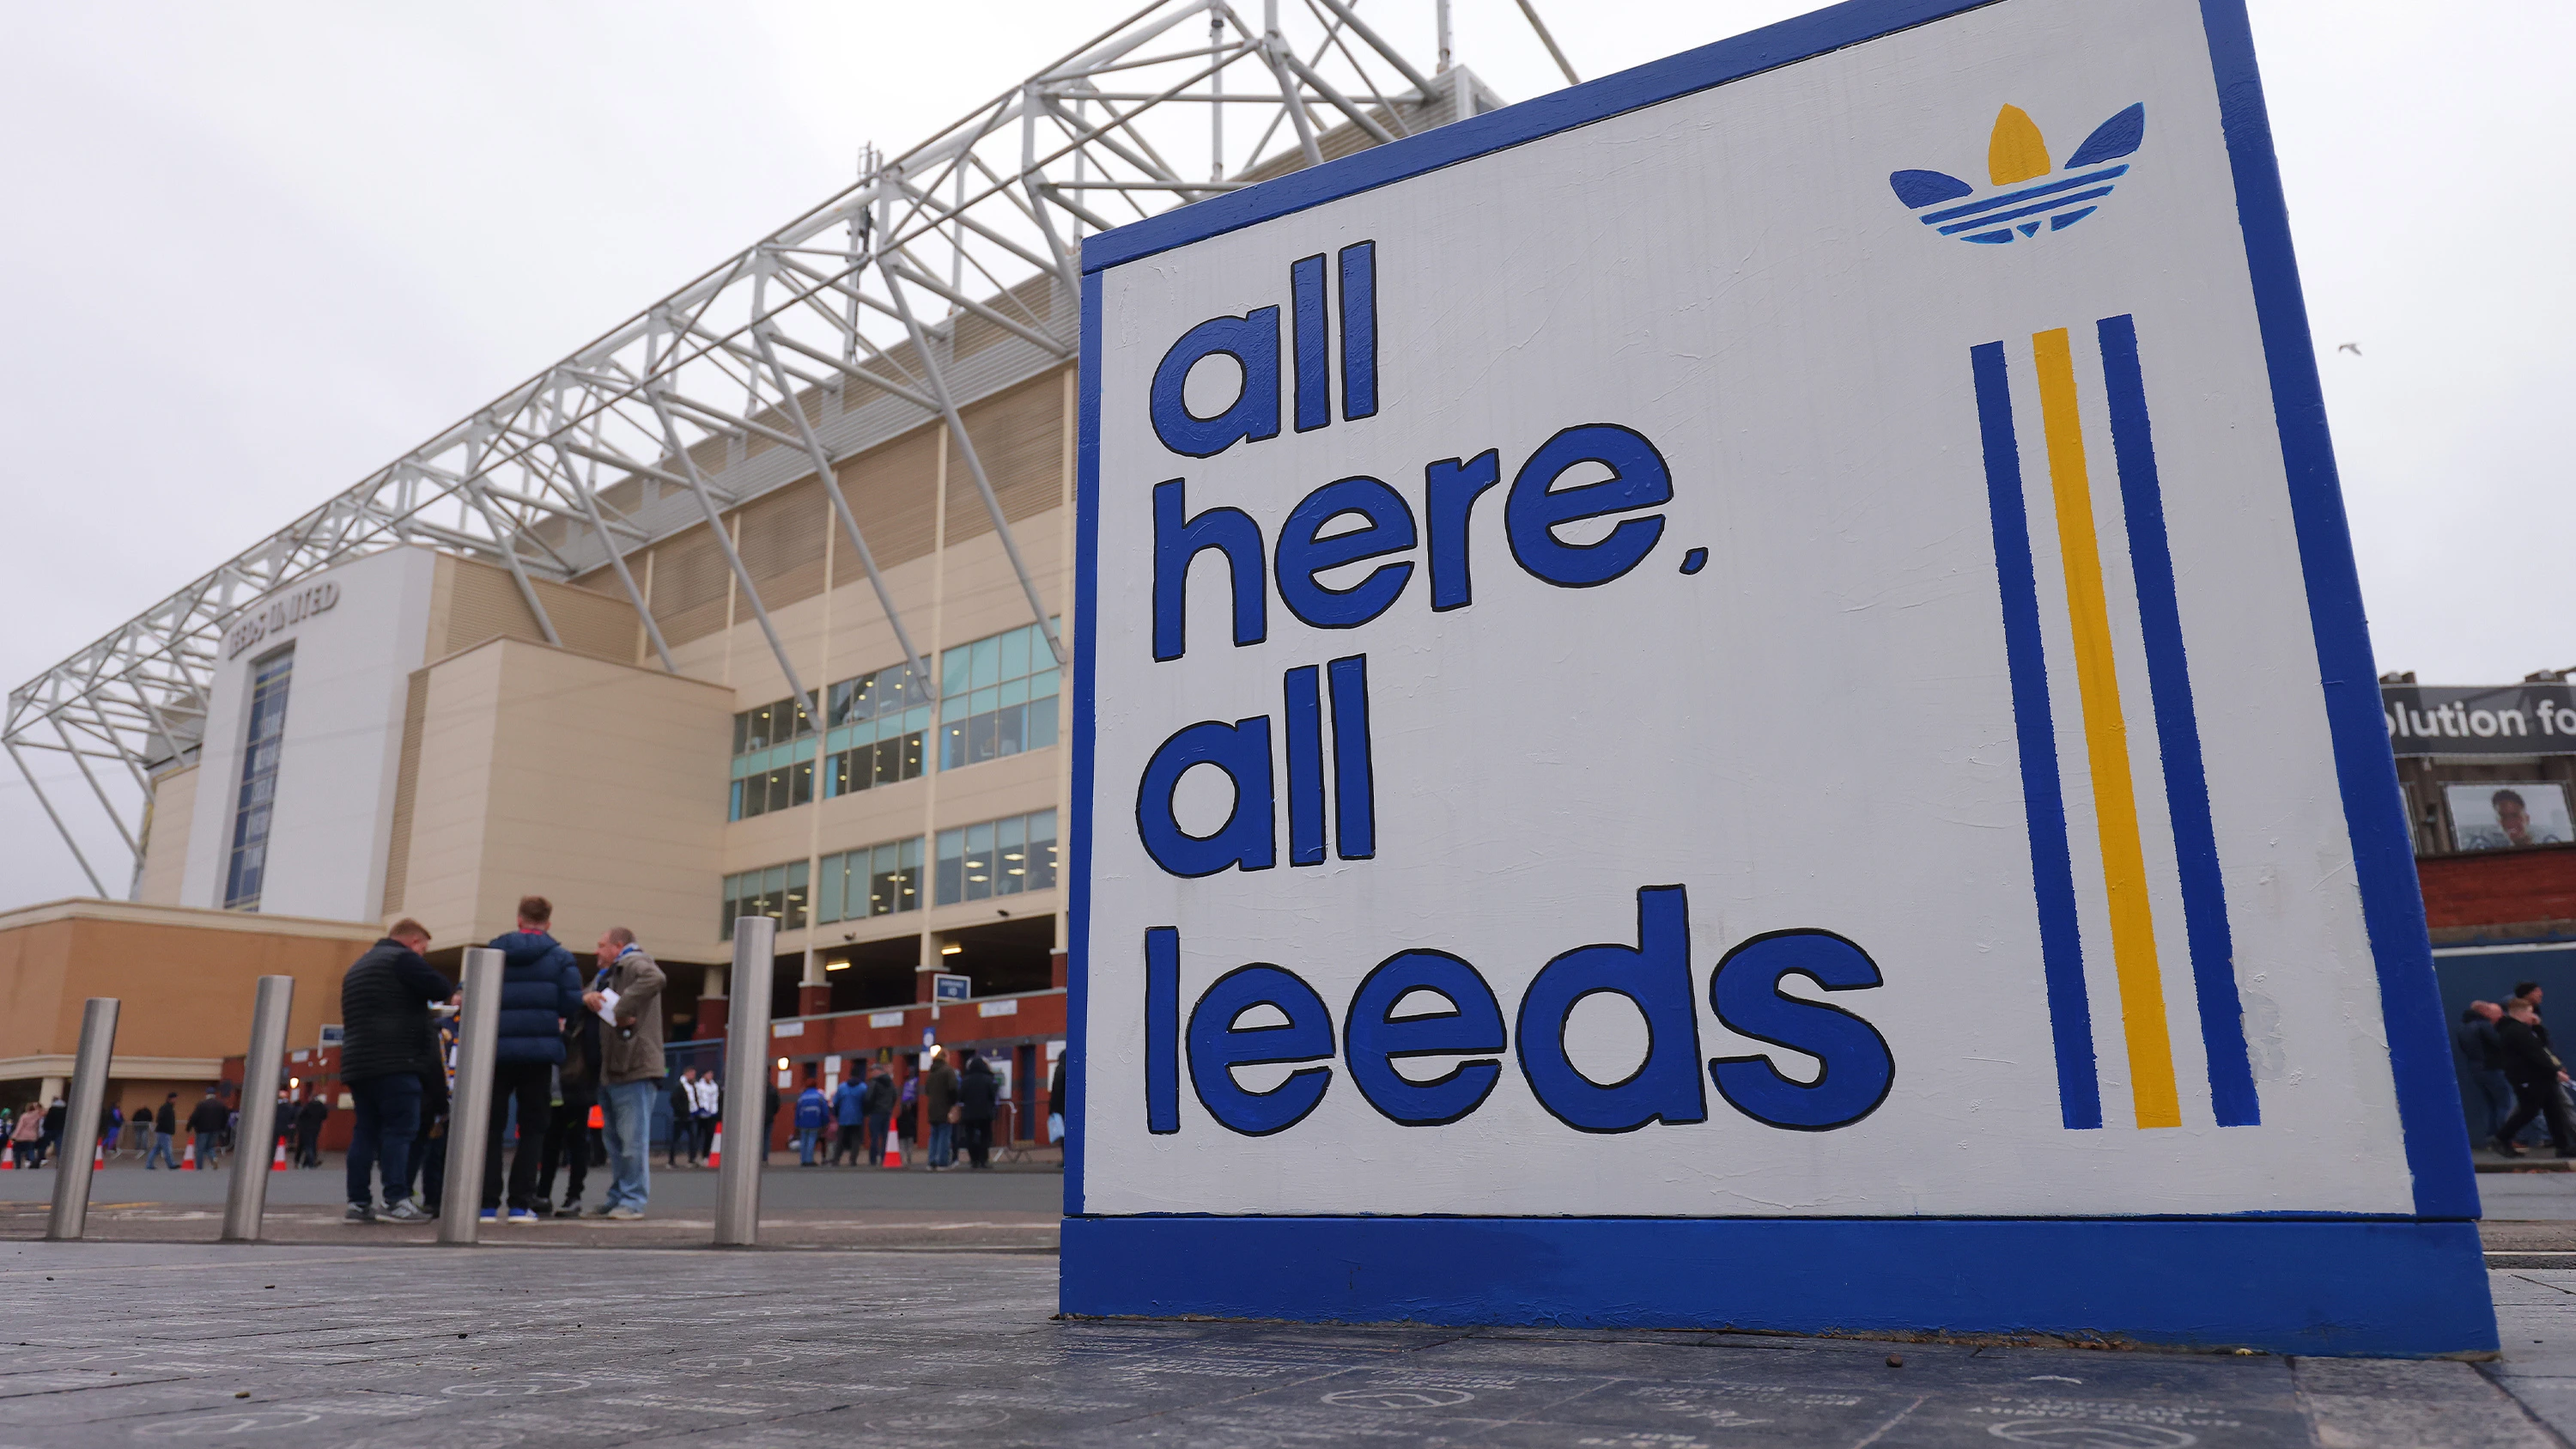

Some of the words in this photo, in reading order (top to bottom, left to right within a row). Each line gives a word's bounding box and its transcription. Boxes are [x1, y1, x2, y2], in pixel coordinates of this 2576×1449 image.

[1150, 239, 1378, 459] all
[1152, 423, 1709, 663] here,
[1135, 653, 1376, 879] all
[1145, 883, 1895, 1137] leeds
